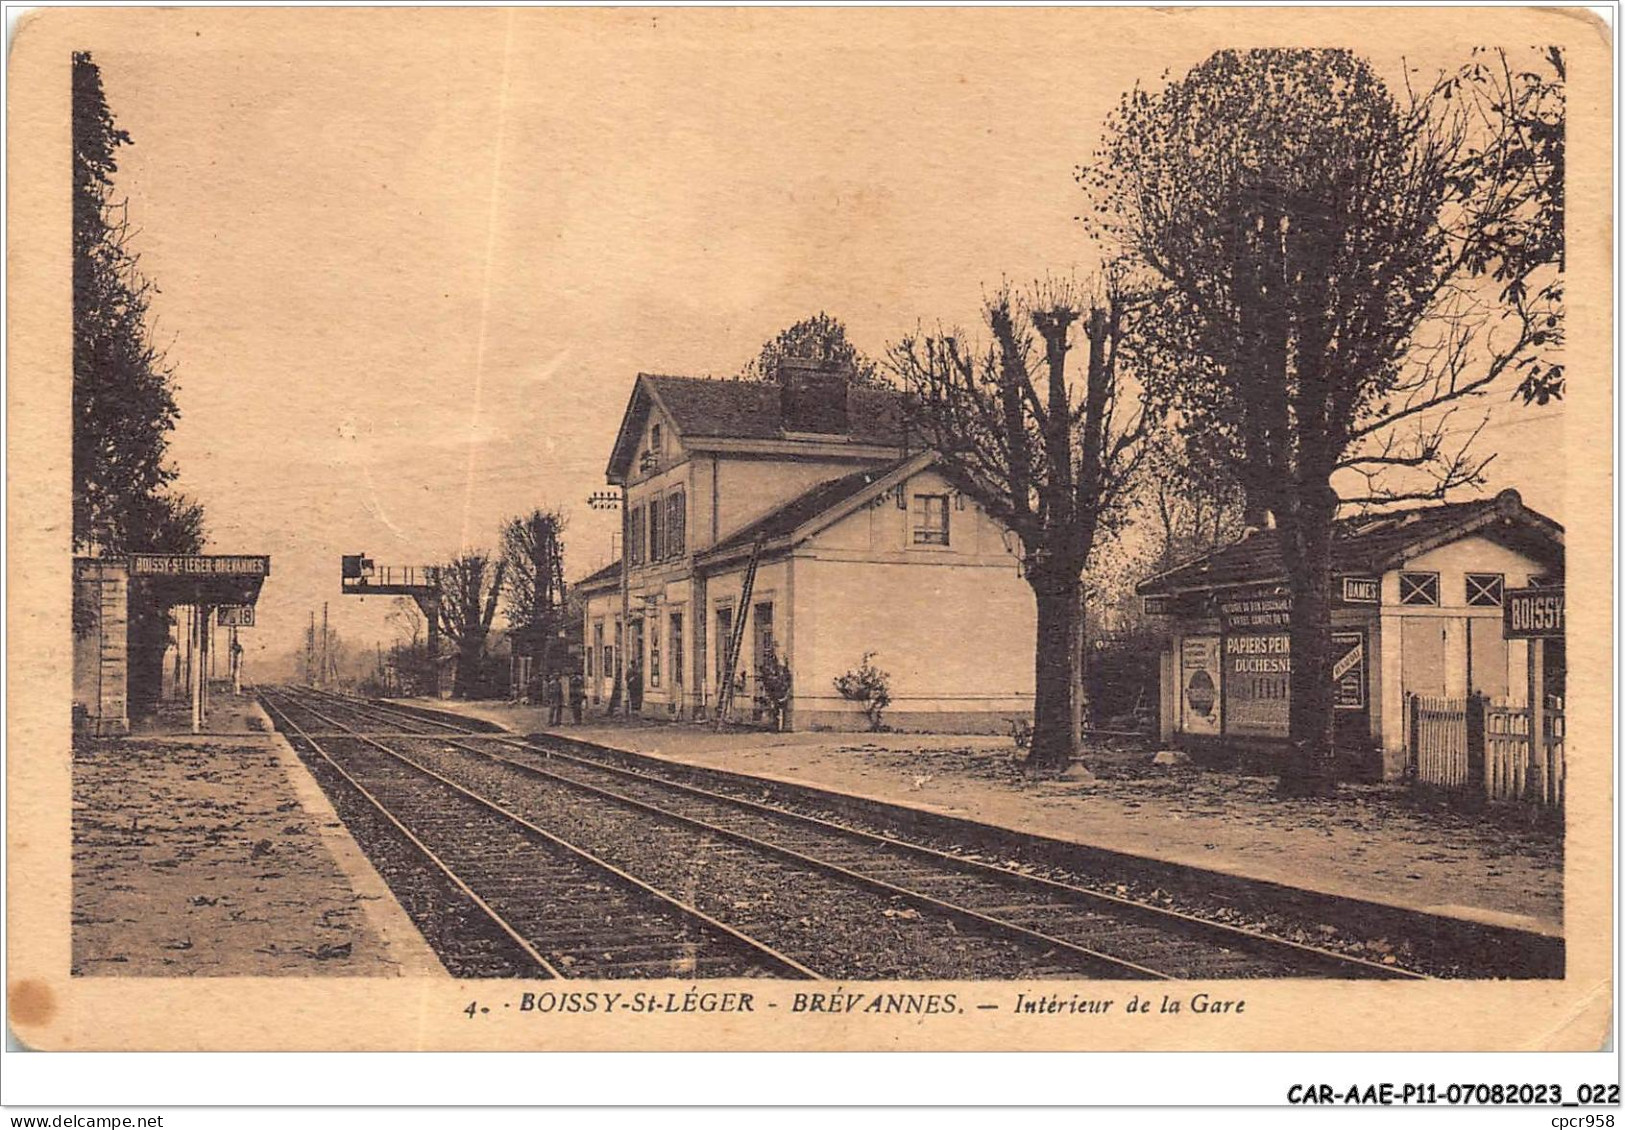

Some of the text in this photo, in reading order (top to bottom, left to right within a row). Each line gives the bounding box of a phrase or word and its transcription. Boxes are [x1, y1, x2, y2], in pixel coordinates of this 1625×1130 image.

[1348, 582, 1377, 598] DAMES
[1512, 597, 1563, 630] BOISSY
[1227, 637, 1268, 654] PAPIERS
